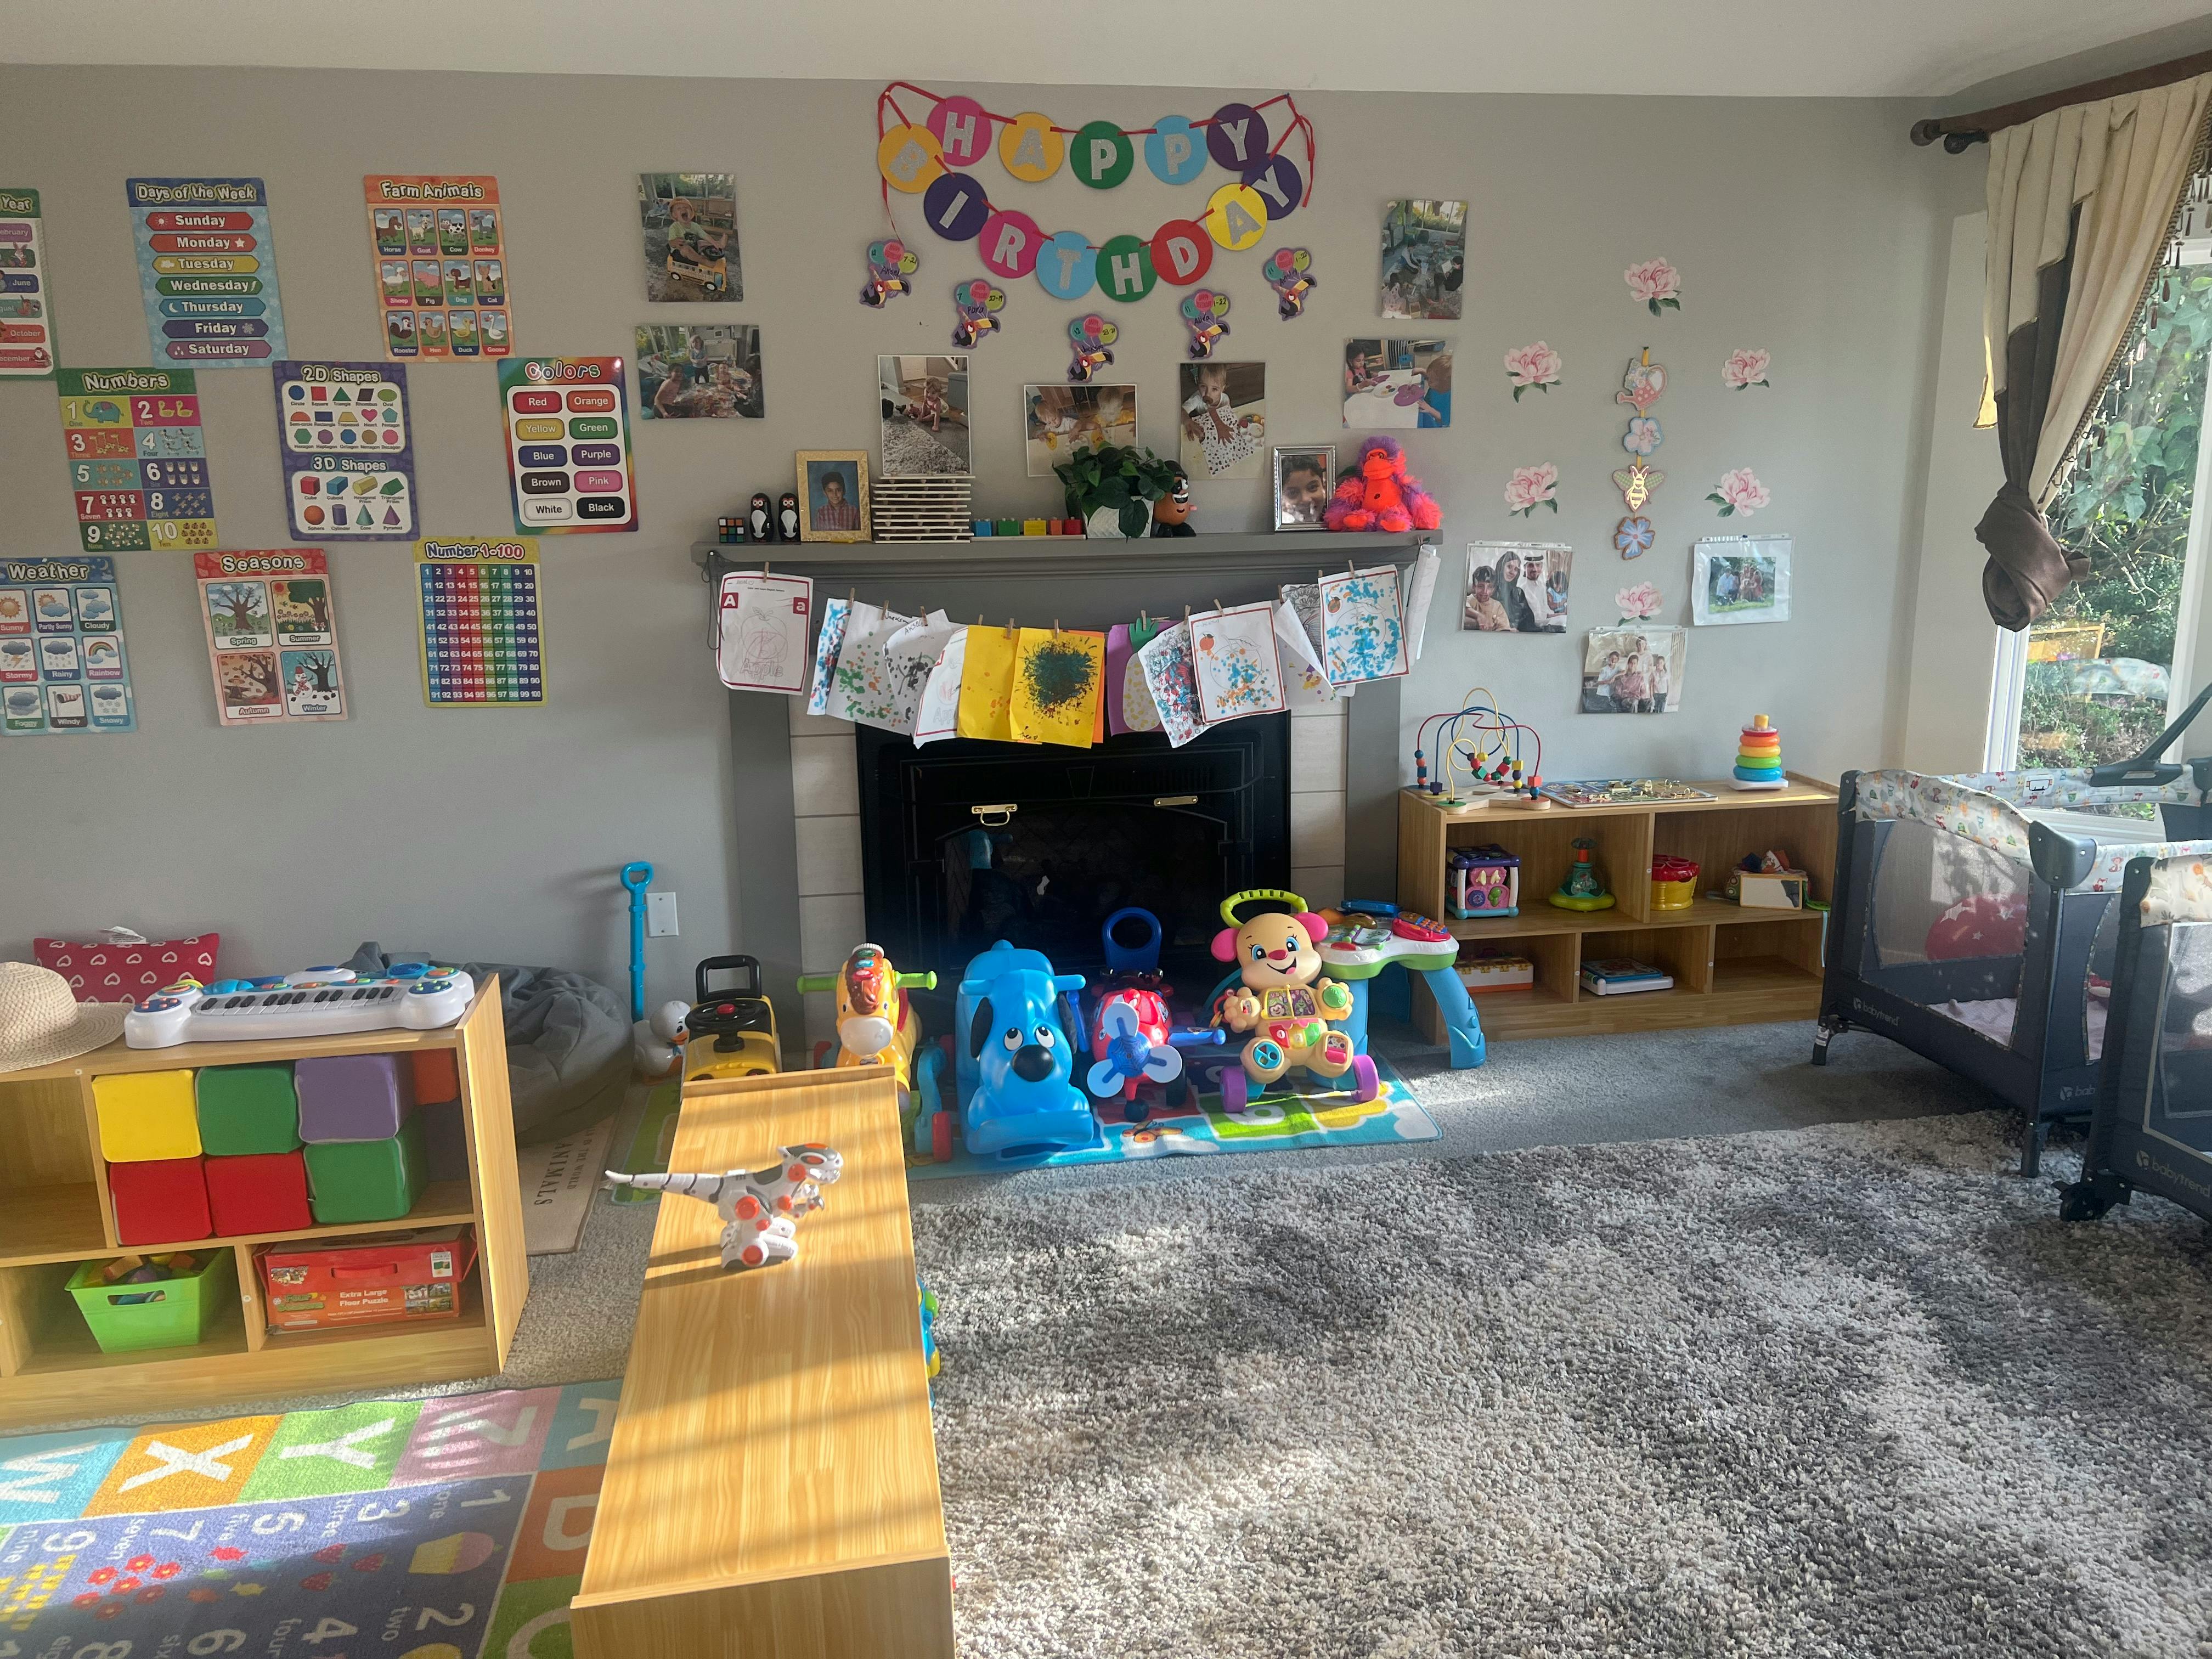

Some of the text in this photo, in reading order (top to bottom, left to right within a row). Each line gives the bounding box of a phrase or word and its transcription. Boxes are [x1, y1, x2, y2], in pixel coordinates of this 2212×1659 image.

[942, 111, 1250, 179] HAPPY
[138, 184, 255, 202] Days of the Week
[382, 182, 483, 198] Farm Animals
[2, 196, 30, 211] Year
[175, 215, 225, 227] Sunday
[888, 139, 1290, 295] BIRTHDAY
[177, 237, 230, 250] Monday
[178, 258, 234, 270] Tuesday
[171, 280, 249, 292] Wednesday
[182, 301, 243, 314] Thursday
[195, 323, 236, 335] Friday
[188, 344, 249, 356] Saturday
[303, 367, 380, 383] 2D Shapes
[525, 360, 601, 380] Colors
[84, 373, 168, 390] Numbers
[67, 401, 76, 419] 1
[138, 400, 153, 419] 2
[528, 398, 547, 406] Red
[574, 397, 608, 407] Orange
[526, 425, 556, 433] Yellow
[71, 433, 86, 452] 3
[142, 432, 155, 450] 4
[581, 450, 611, 459] Purple
[77, 465, 90, 483] 5
[146, 462, 161, 481] 6
[313, 457, 386, 473] 3D Shapes
[532, 478, 561, 487] Brown
[81, 495, 94, 514] 7
[150, 492, 163, 510] 8
[589, 503, 614, 511] Black
[87, 525, 100, 543] 9
[151, 522, 178, 540] 10
[426, 543, 524, 559] Number 1-100
[8, 563, 88, 580] Weather
[222, 556, 304, 572] Seasons
[724, 594, 736, 607] A
[796, 601, 805, 611] a
[1863, 1000, 1899, 1026] babytrend
[534, 1143, 574, 1205] ANIMALS
[2152, 1156, 2211, 1198] babytrend
[422, 1406, 539, 1458] Z
[279, 1418, 396, 1470] Y
[0, 1441, 99, 1503] W
[117, 1434, 254, 1493] X
[460, 1489, 511, 1508] 1
[357, 1500, 410, 1522] 3
[150, 1519, 204, 1542] 7
[252, 1511, 306, 1535] 5
[41, 1531, 97, 1552] 9
[381, 1606, 411, 1641] two
[416, 1602, 475, 1630] 2
[302, 1617, 358, 1644] 4
[188, 1628, 247, 1656] 6
